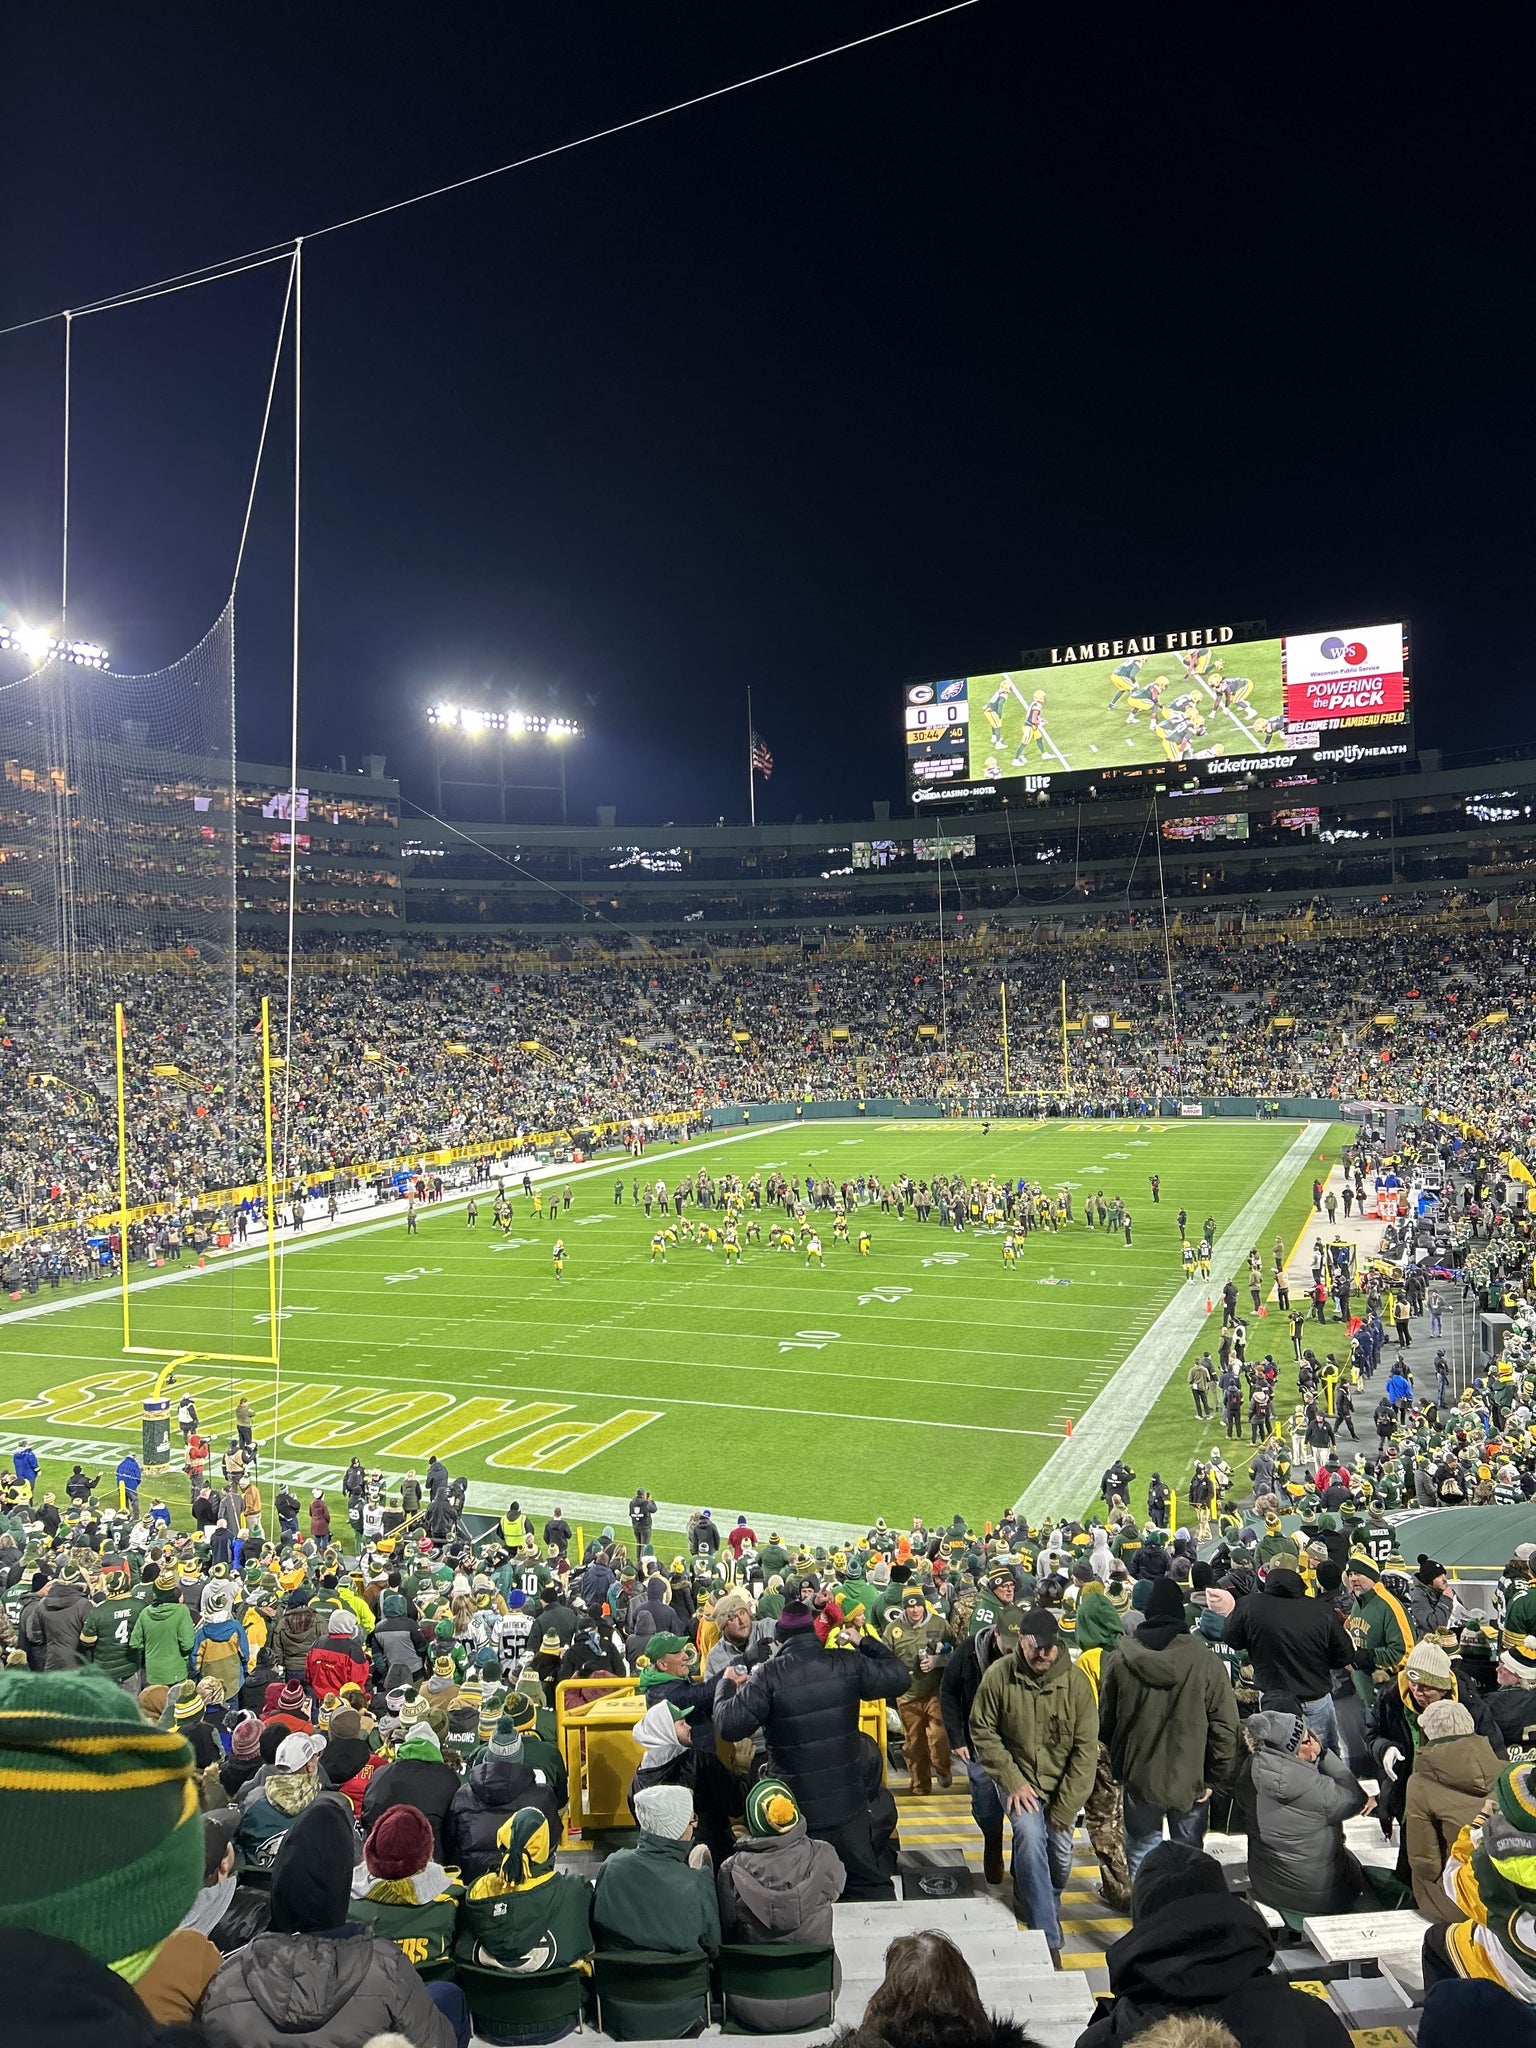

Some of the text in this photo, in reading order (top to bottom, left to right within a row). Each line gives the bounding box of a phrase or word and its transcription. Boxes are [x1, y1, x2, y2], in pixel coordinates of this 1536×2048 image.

[1051, 626, 1234, 664] LAMBEAU FIELD
[1330, 645, 1356, 659] WPS
[1310, 670, 1339, 678] Wisconsin
[1340, 667, 1358, 675] Public
[1306, 677, 1383, 697] POWERING
[1313, 691, 1385, 710] the PACK
[917, 706, 957, 725] 0 0
[1288, 712, 1405, 733] WELCOME TO LAMBEAU FIELD
[912, 731, 940, 742] 30:44
[1207, 754, 1298, 774] ticketmaster
[941, 789, 969, 799] CASINO
[973, 786, 997, 796] HOTEL
[1025, 775, 1051, 792] Lite
[857, 1285, 914, 1306] 20
[778, 1329, 842, 1354] 10
[0, 1370, 666, 1475] PACKERS
[365, 1514, 375, 1525] 10
[1368, 1539, 1392, 1561] 12
[521, 1574, 538, 1596] 10
[502, 1621, 527, 1630] MATTHEWS
[975, 1608, 995, 1624] 92
[114, 1620, 129, 1644] 4
[502, 1635, 529, 1660] 52
[1496, 1838, 1533, 1851] PACKERS
